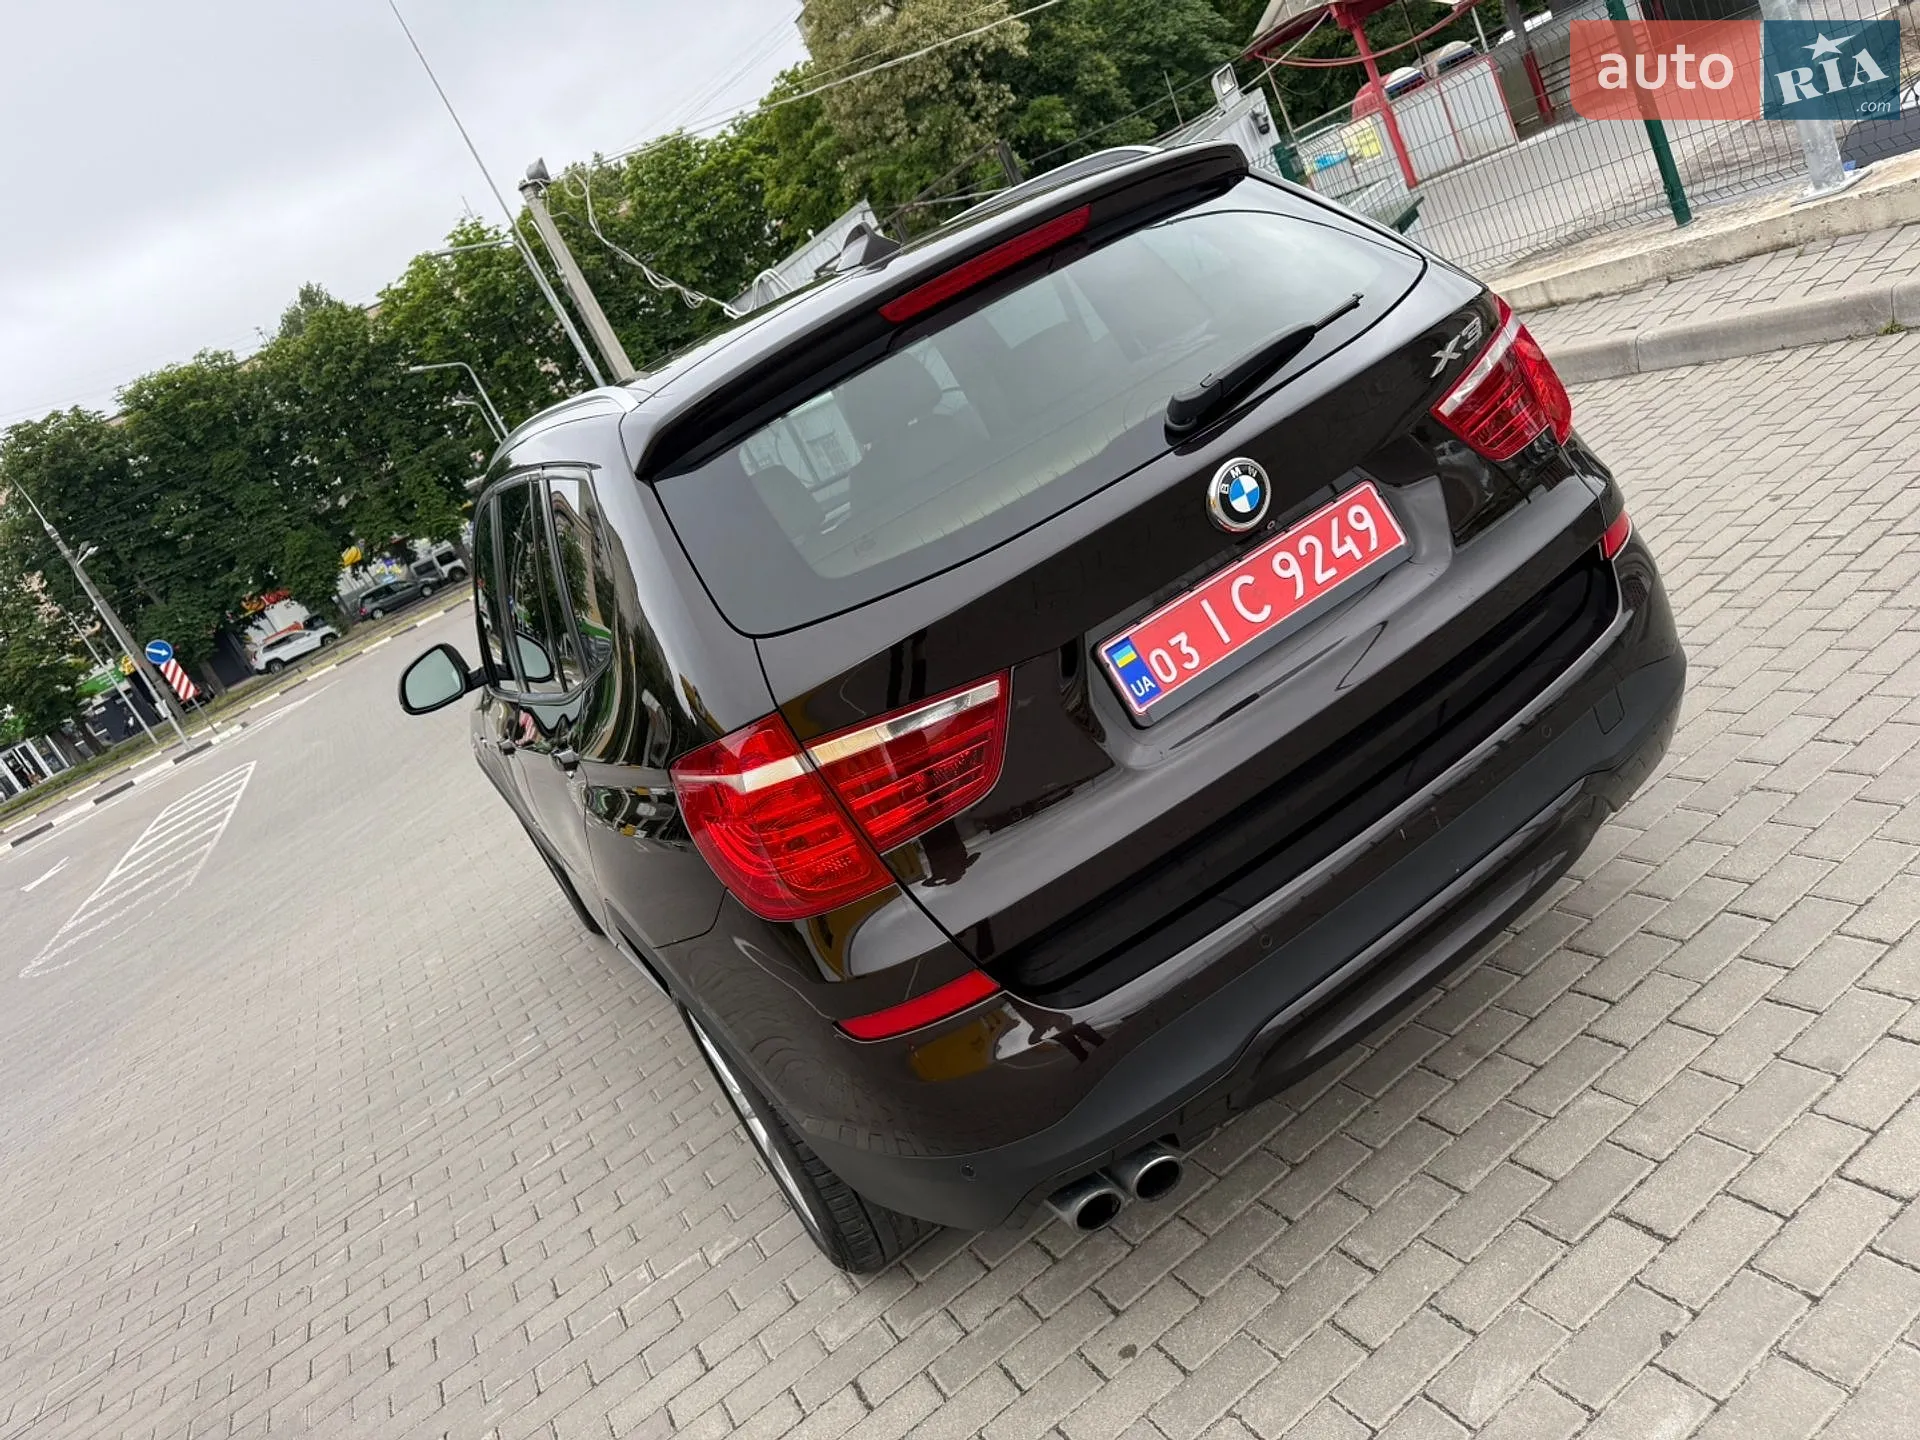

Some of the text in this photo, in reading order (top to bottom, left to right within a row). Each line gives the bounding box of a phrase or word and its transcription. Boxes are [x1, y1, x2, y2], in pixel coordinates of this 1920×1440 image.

[1429, 316, 1482, 379] X3
[1219, 465, 1260, 495] BMW
[1149, 504, 1379, 684] 03 IC 9249
[1130, 674, 1156, 698] UA
